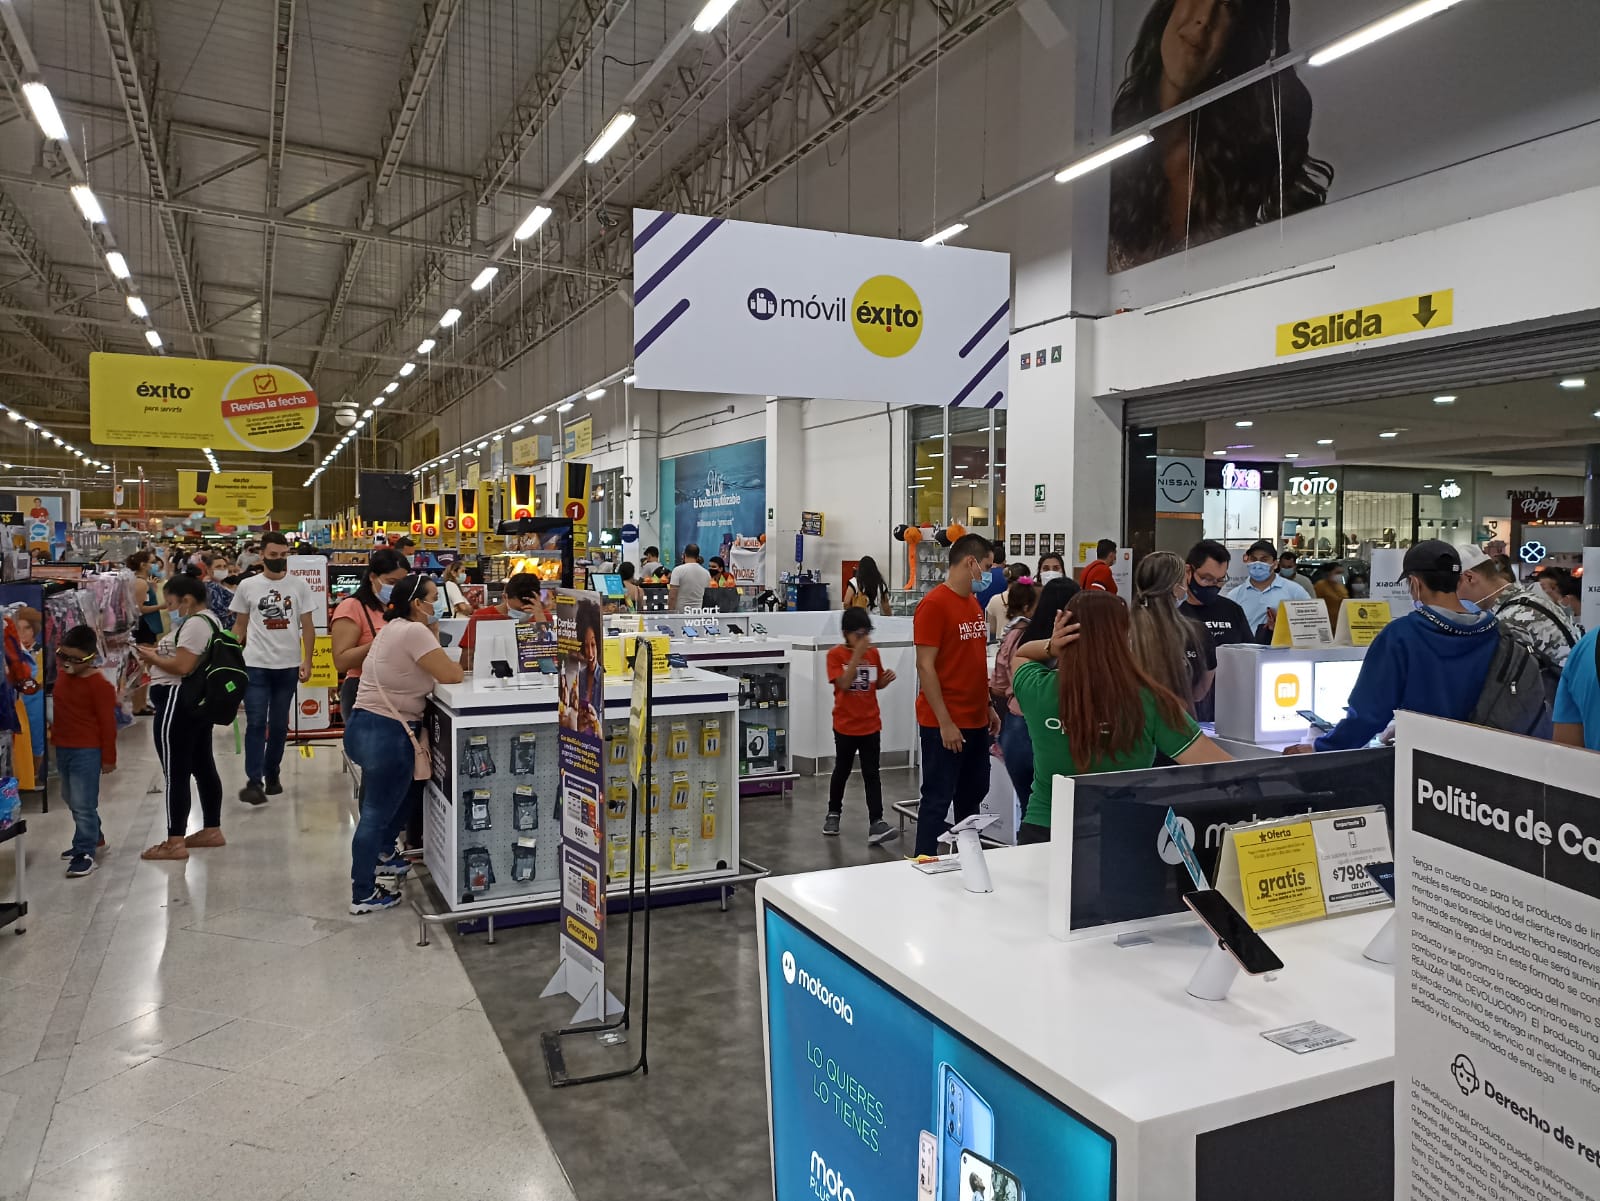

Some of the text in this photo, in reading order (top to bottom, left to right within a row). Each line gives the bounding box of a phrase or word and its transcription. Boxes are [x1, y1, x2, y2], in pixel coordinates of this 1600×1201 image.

[780, 295, 921, 333] móvil éxito
[1291, 310, 1382, 351] Salida
[136, 381, 191, 403] éxito
[230, 395, 307, 413] Revisa la fecha
[698, 496, 712, 508] bolsa
[1157, 478, 1198, 487] NISSAN
[1289, 476, 1338, 496] TOTTO
[447, 520, 454, 529] 5
[465, 519, 472, 527] 4
[571, 505, 579, 518] 1
[1520, 498, 1560, 518] Popsy
[684, 605, 720, 615] Smart
[684, 616, 719, 627] watch
[1417, 778, 1510, 833] Política
[1514, 809, 1553, 846] de
[1266, 829, 1292, 840] Oferta
[1258, 867, 1306, 898] gratis
[1412, 856, 1433, 871] Tenga
[1434, 867, 1444, 875] en
[1445, 871, 1471, 887] cuenta
[1490, 889, 1509, 903] para
[1512, 896, 1524, 909] los
[1526, 904, 1572, 929] productos
[1574, 923, 1587, 935] de
[1434, 894, 1442, 902] en
[1444, 898, 1457, 910] que
[1458, 903, 1468, 915] los
[1495, 919, 1512, 934] Una
[1513, 929, 1527, 940] vez
[1528, 933, 1556, 954] hecha
[1557, 949, 1577, 963] esta
[1441, 883, 1449, 892] es
[1450, 887, 1510, 918] responsabilidad
[1511, 912, 1524, 924] del
[1525, 919, 1555, 937] cliente
[1439, 910, 1449, 920] de
[1449, 915, 1478, 934] entrega
[1479, 928, 1492, 939] del
[1493, 935, 1531, 957] producto
[1531, 953, 1549, 966] que
[1411, 929, 1442, 949] producto
[1448, 948, 1457, 956] se
[1457, 952, 1496, 976] programa
[1496, 969, 1504, 980] la
[1505, 976, 1543, 999] recogida
[1545, 994, 1559, 1007] del
[1496, 949, 1507, 962] En
[1509, 957, 1527, 971] este
[1529, 964, 1565, 989] formato
[1567, 985, 1578, 996] se
[798, 968, 854, 1026] motorola
[1411, 954, 1445, 976] REALIZAR
[1447, 973, 1463, 987] UNA
[1543, 1025, 1585, 1052] producto
[1437, 956, 1449, 965] por
[1450, 961, 1466, 975] talla
[1494, 985, 1504, 995] en
[1505, 991, 1525, 1006] caso
[1568, 1022, 1579, 1034] es
[1580, 1029, 1599, 1044] una
[1442, 986, 1470, 1006] cambio
[1470, 1000, 1484, 1013] NO
[1484, 1009, 1493, 1019] se
[1494, 1015, 1526, 1037] entrega
[1419, 987, 1450, 1009] producto
[1493, 1029, 1524, 1051] servicio
[1526, 1047, 1534, 1057] al
[1448, 1015, 1469, 1034] fecha
[1470, 1030, 1506, 1056] estimada
[1507, 1052, 1519, 1064] de
[807, 1040, 888, 1129] LO QUIERES.
[813, 1073, 882, 1156] LO TIENES.
[1458, 1109, 1470, 1121] del
[1471, 1118, 1506, 1146] producto
[1484, 1079, 1550, 1134] Derecho
[1553, 1125, 1575, 1150] de
